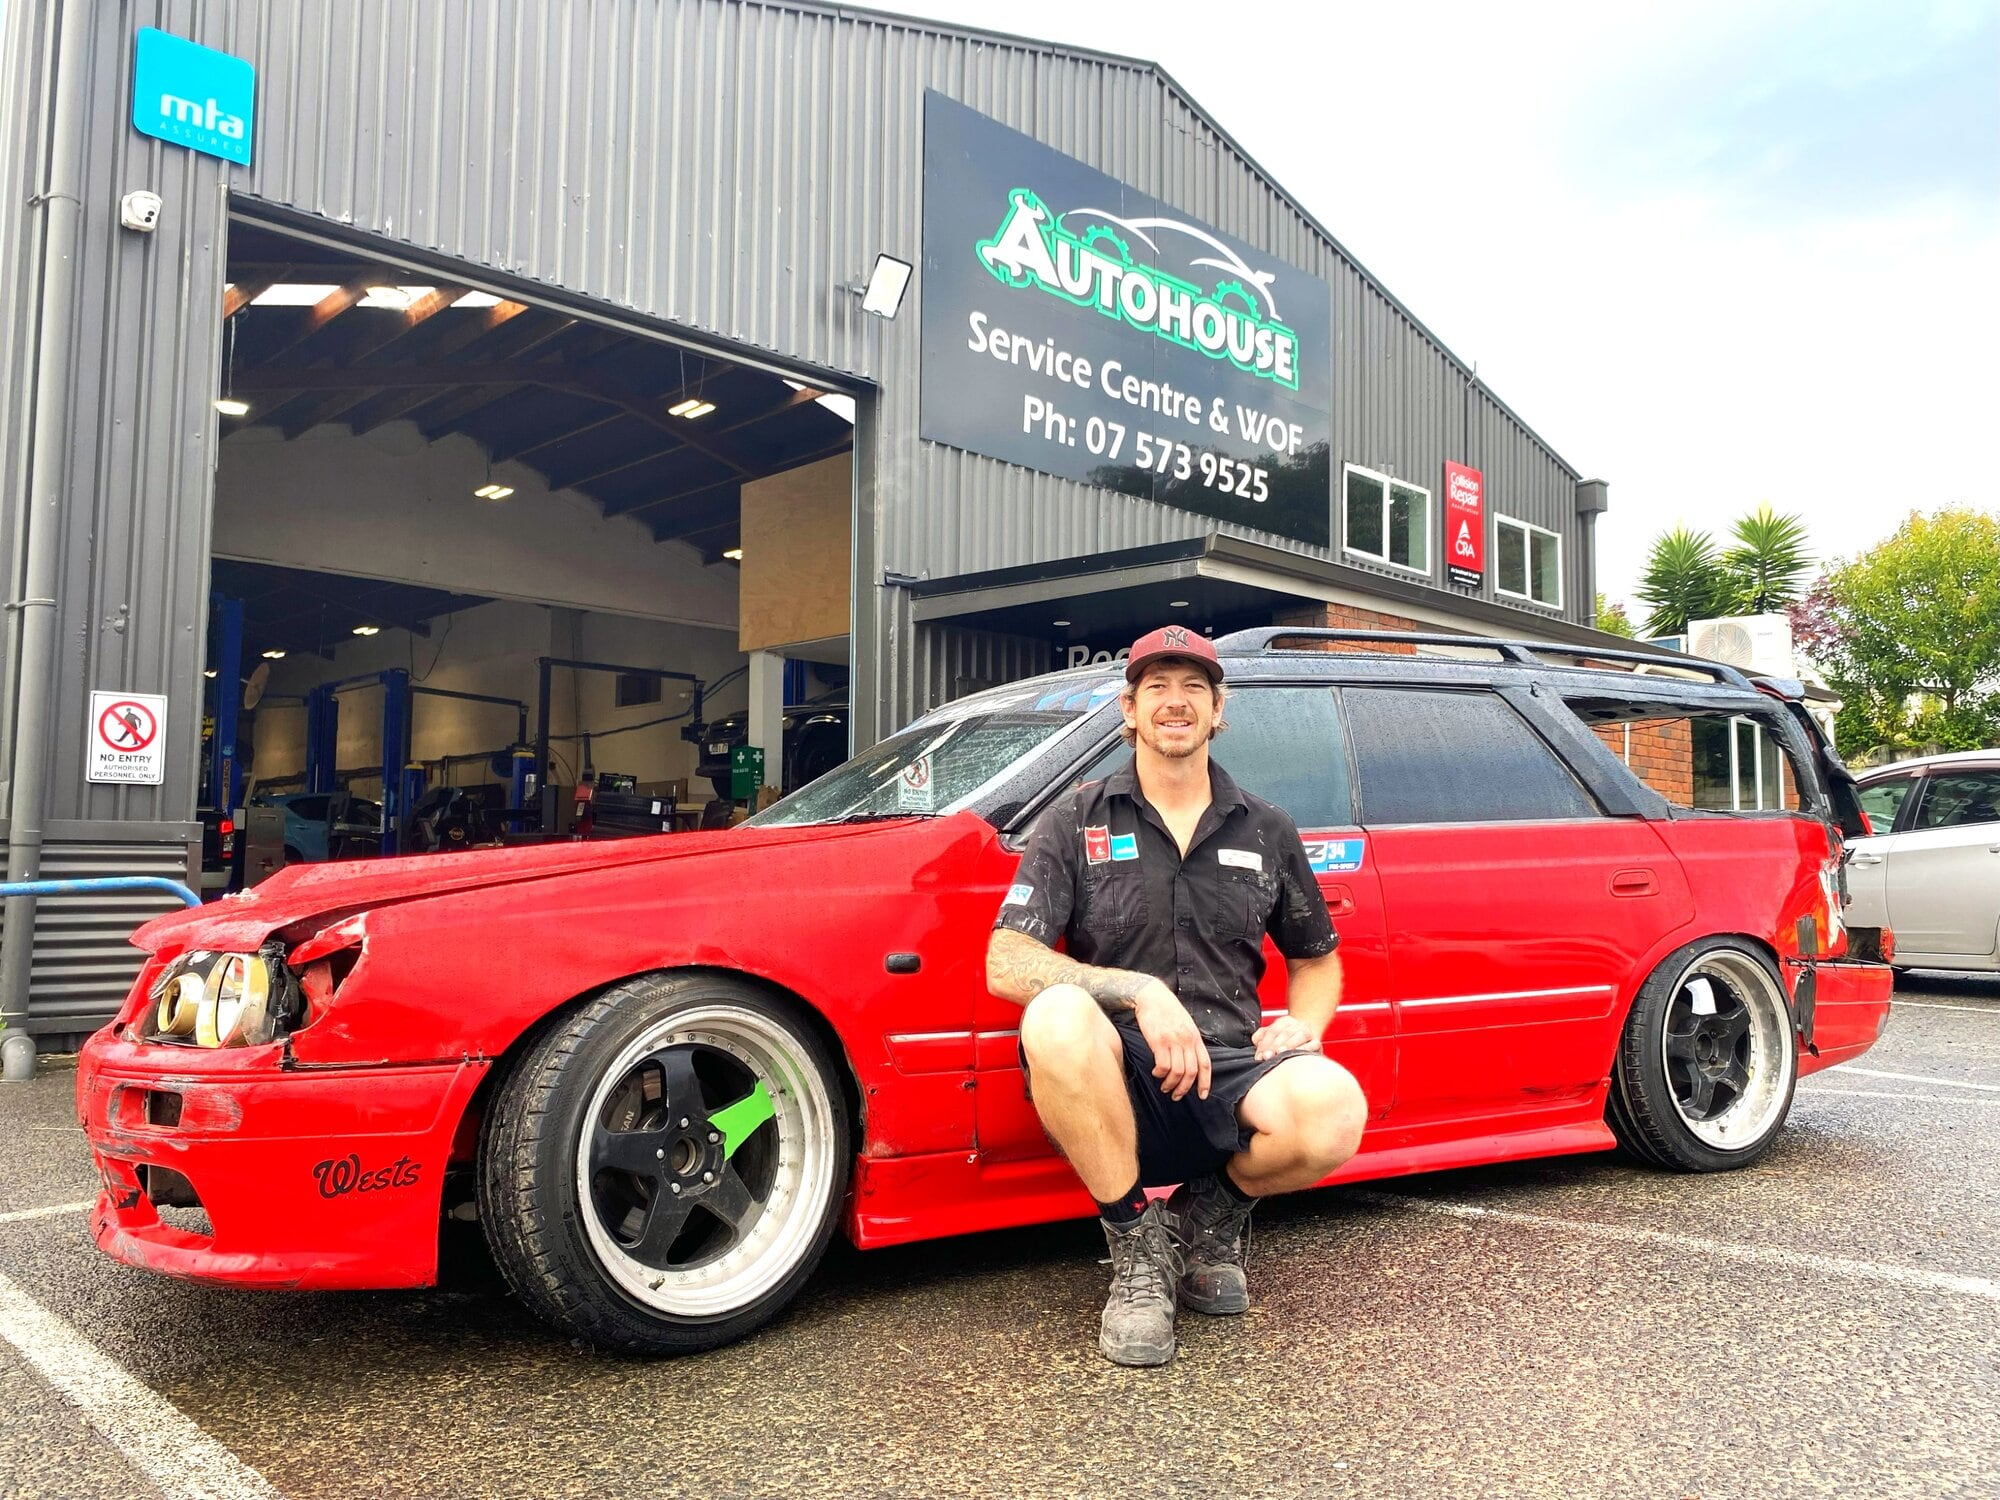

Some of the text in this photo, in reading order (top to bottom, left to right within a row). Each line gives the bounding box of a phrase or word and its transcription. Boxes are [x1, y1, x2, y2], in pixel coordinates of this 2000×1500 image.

[160, 93, 244, 140] mta
[980, 194, 1294, 382] AUTOHOUSE
[968, 311, 1303, 456] Service Centre & WOF
[1023, 394, 1269, 502] Ph: 07 573 9525
[1450, 472, 1479, 494] Collision
[1450, 484, 1479, 507] Repair
[94, 771, 137, 779] PERSONNEL
[100, 754, 152, 763] NO ENTRY
[313, 1153, 422, 1199] Wests
